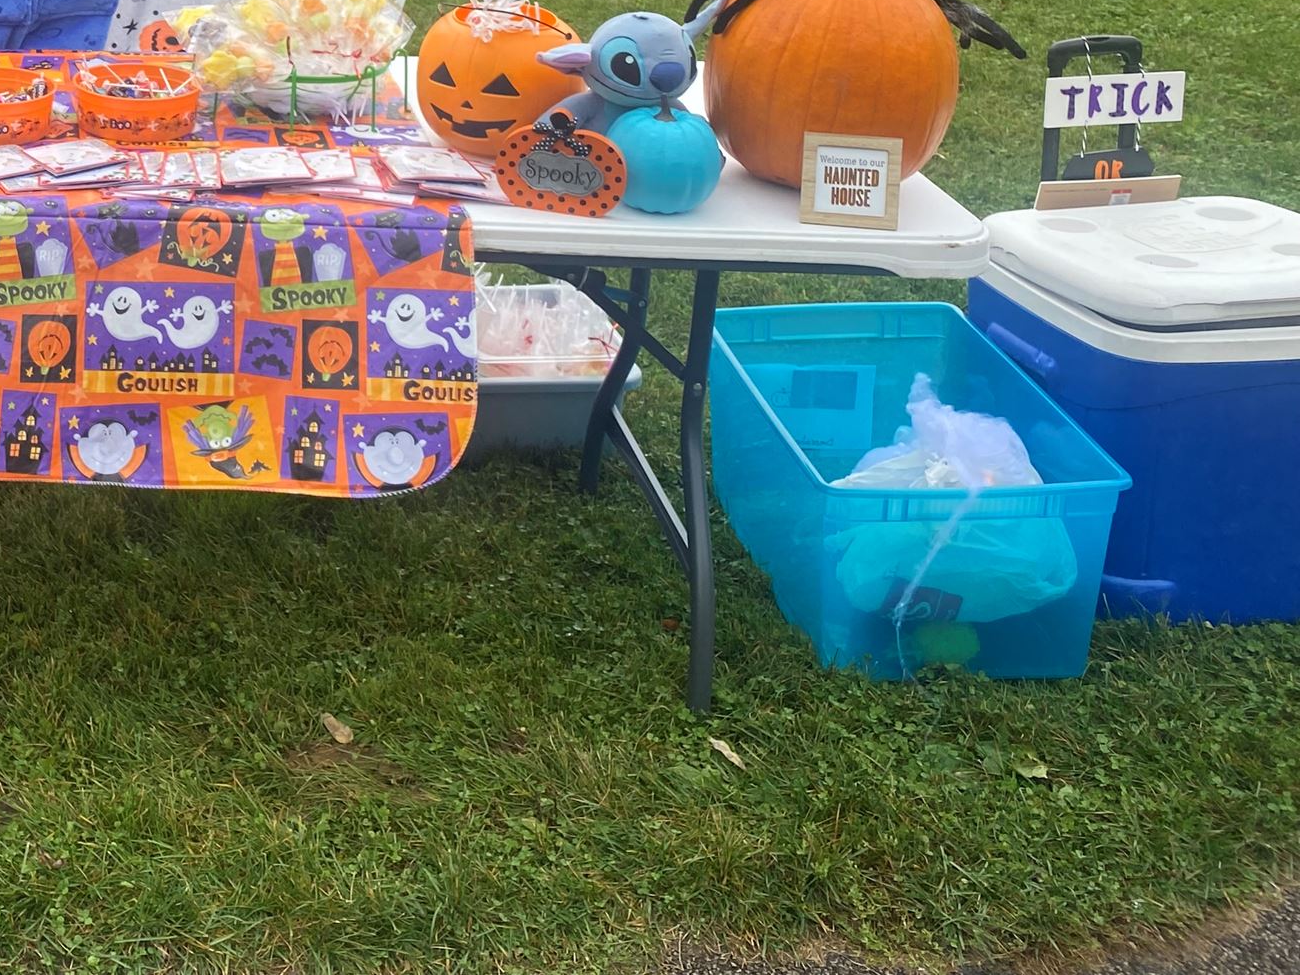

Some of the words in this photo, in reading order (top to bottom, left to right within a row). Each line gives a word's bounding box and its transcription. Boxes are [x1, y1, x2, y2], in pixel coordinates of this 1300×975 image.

[1060, 80, 1173, 120] TRICK
[819, 155, 857, 165] Welcome
[859, 158, 868, 166] to
[1094, 160, 1124, 180] OR
[525, 158, 597, 190] Spooky
[824, 166, 879, 187] HAUNTED
[831, 187, 871, 207] HOUSE
[40, 249, 59, 261] RIP
[317, 253, 338, 265] RIP
[272, 287, 347, 310] SPOOKY
[117, 372, 198, 392] GOULISH
[403, 380, 476, 402] GOULIS
